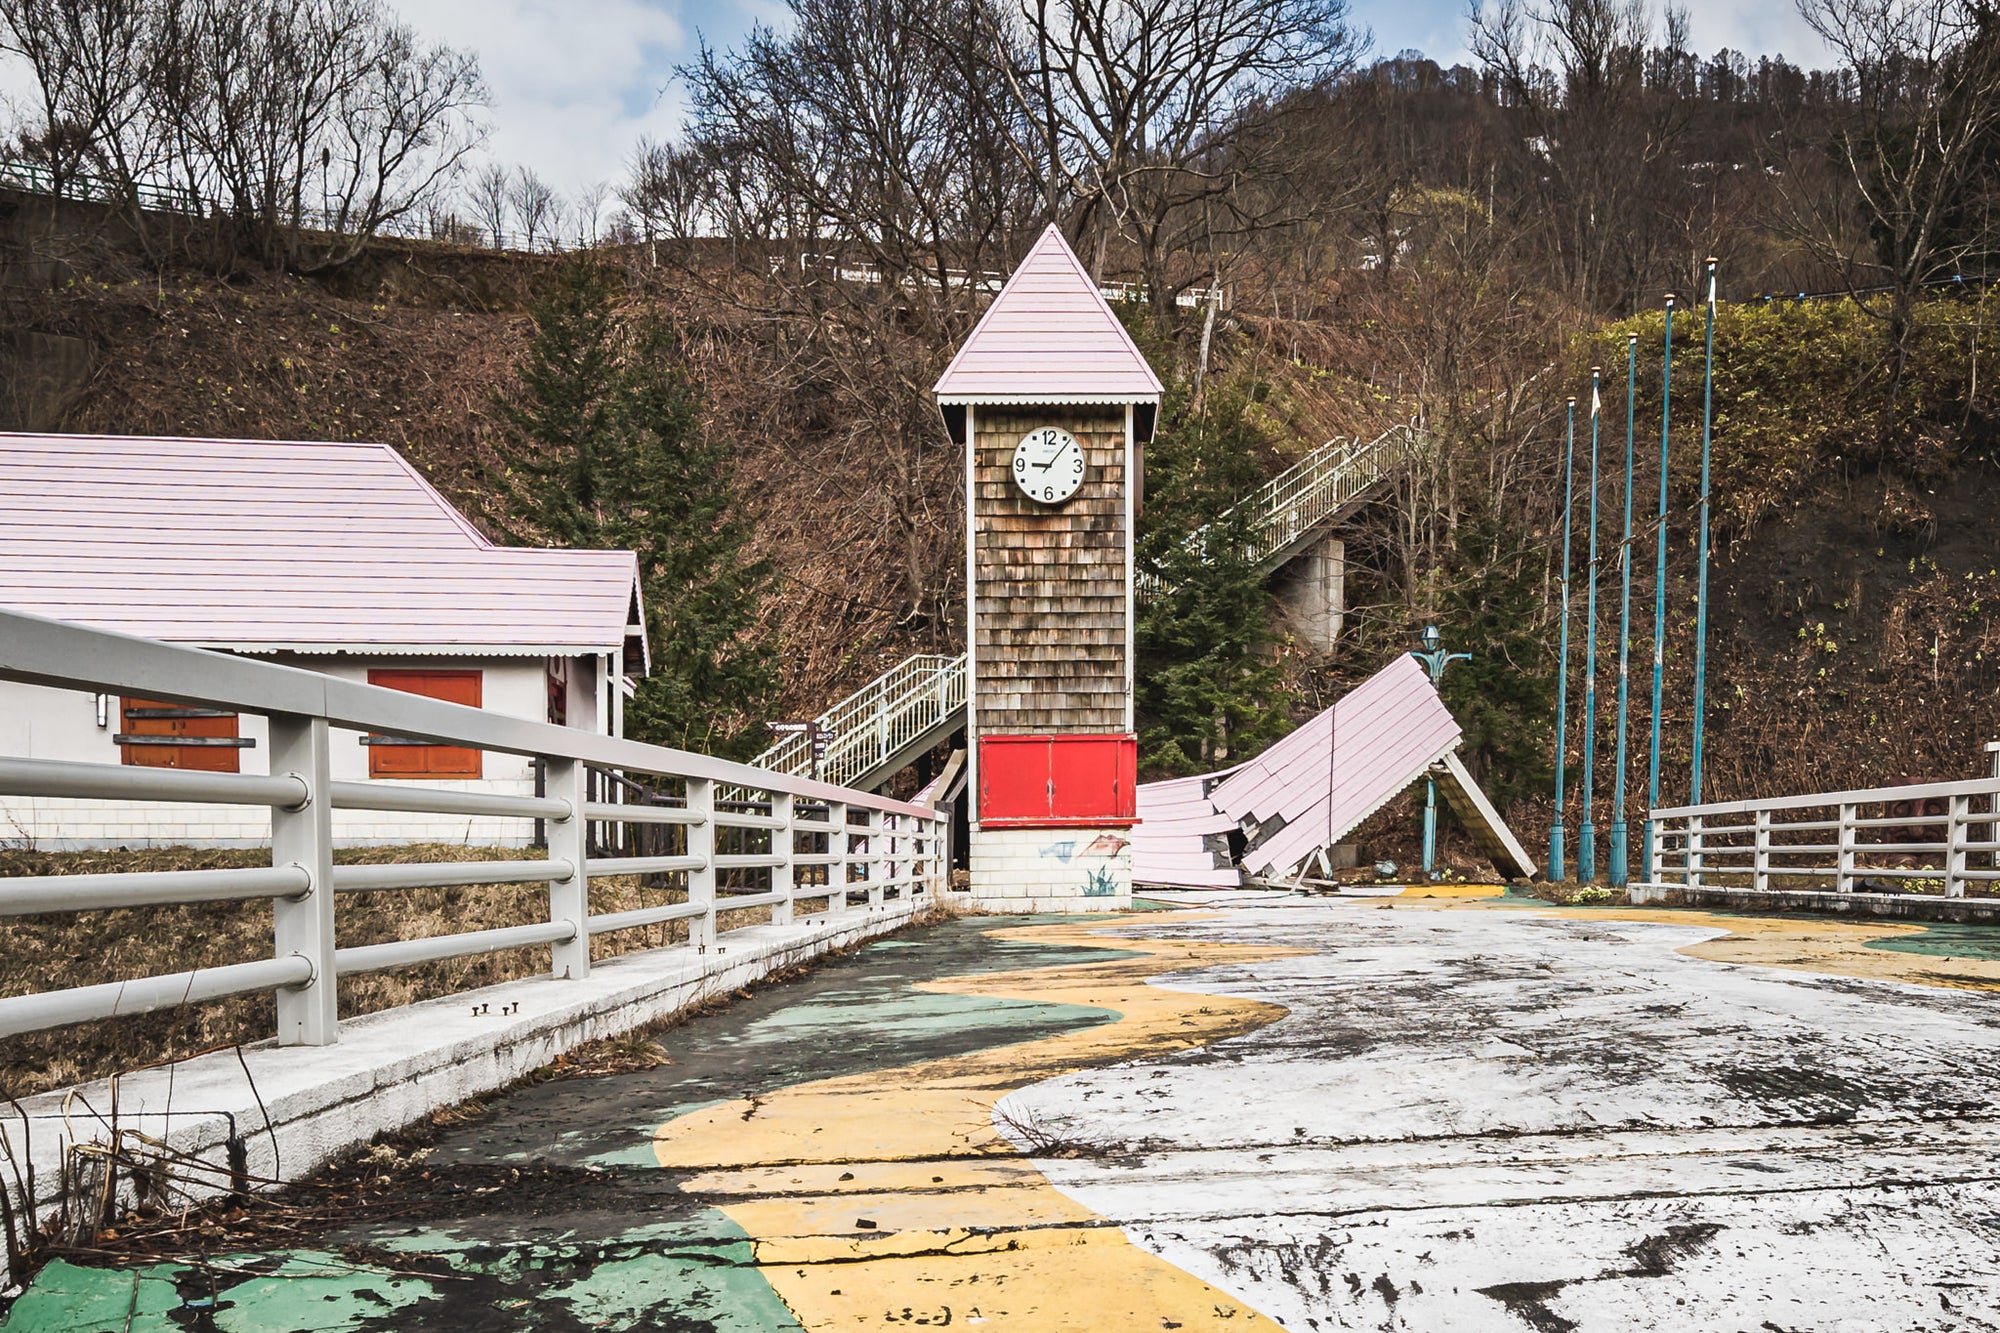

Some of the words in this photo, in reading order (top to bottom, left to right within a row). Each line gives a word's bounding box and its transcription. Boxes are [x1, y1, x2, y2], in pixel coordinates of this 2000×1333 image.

[1042, 430, 1057, 445] 12
[1015, 457, 1025, 472] 9
[1073, 458, 1083, 474] 3
[1044, 486, 1054, 501] 6
